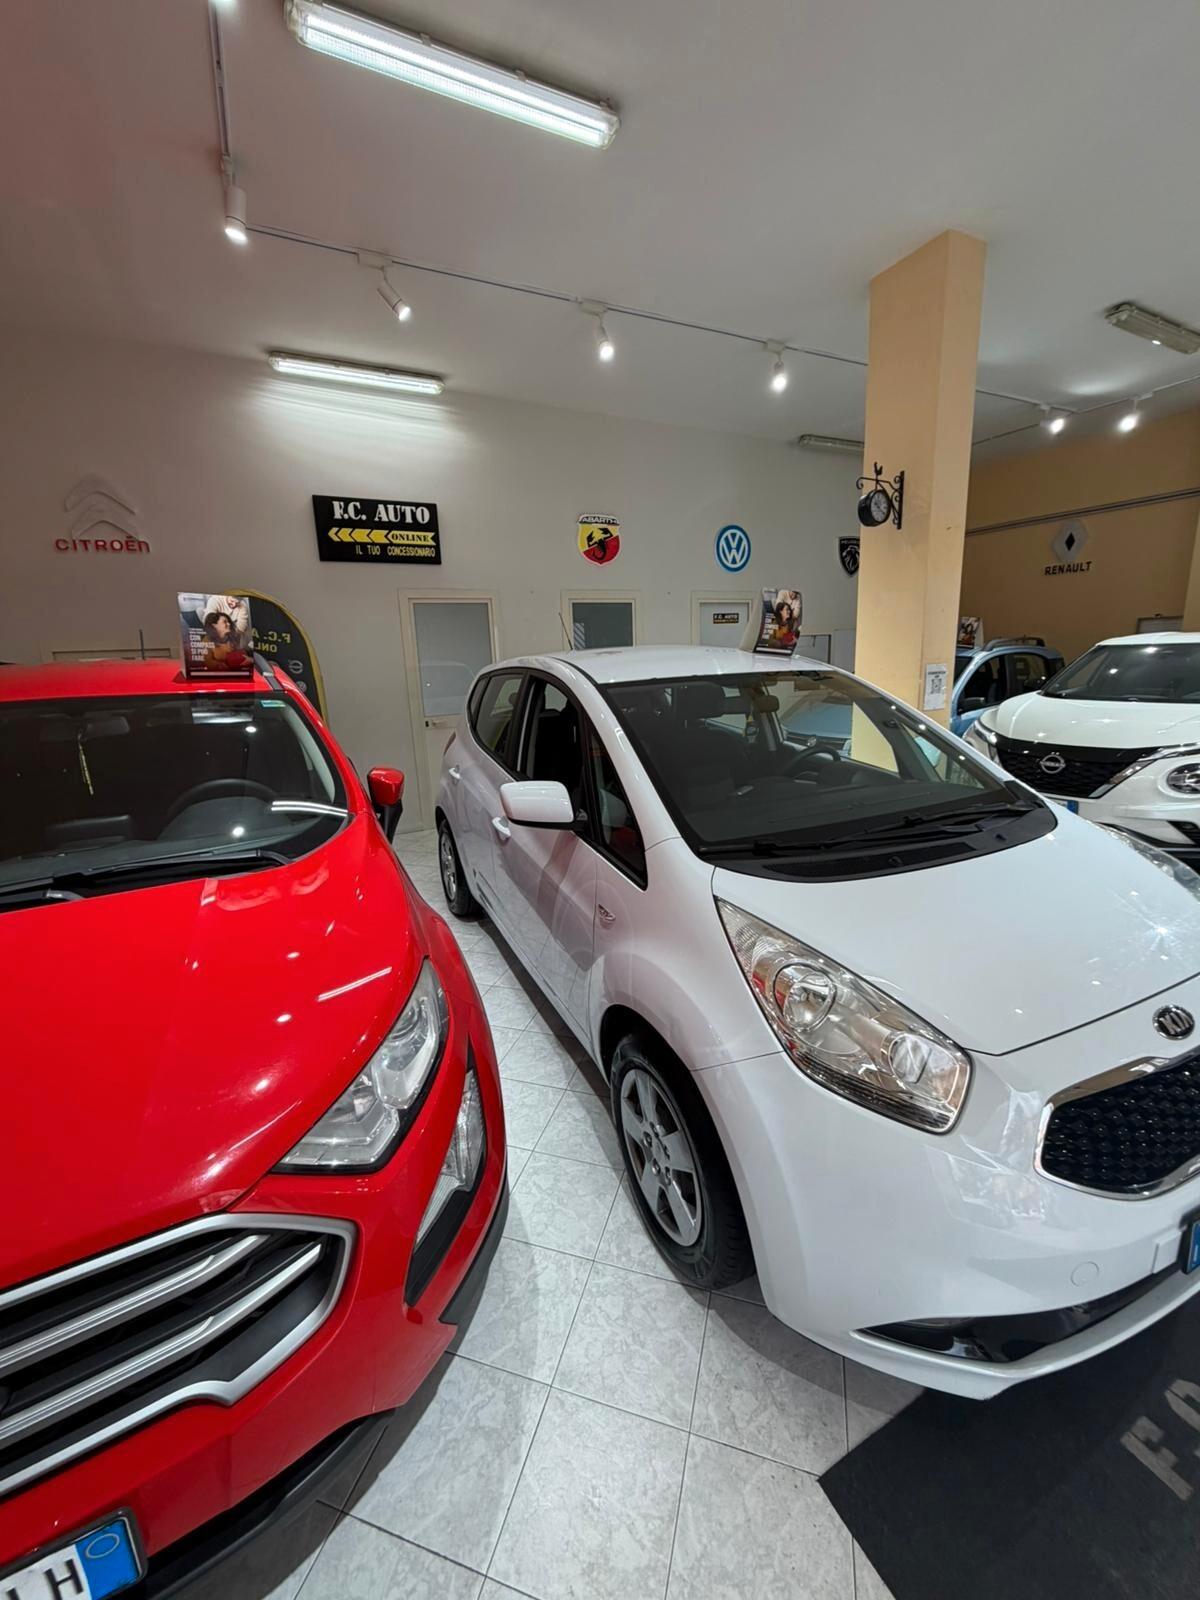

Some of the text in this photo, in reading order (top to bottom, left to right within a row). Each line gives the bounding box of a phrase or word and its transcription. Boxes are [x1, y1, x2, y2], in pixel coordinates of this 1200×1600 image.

[332, 501, 430, 524] F.C. AUTO
[391, 532, 430, 543] ONLINE
[355, 544, 436, 557] IL TUO CONCESSIONARIO
[1044, 560, 1093, 576] RENAULT
